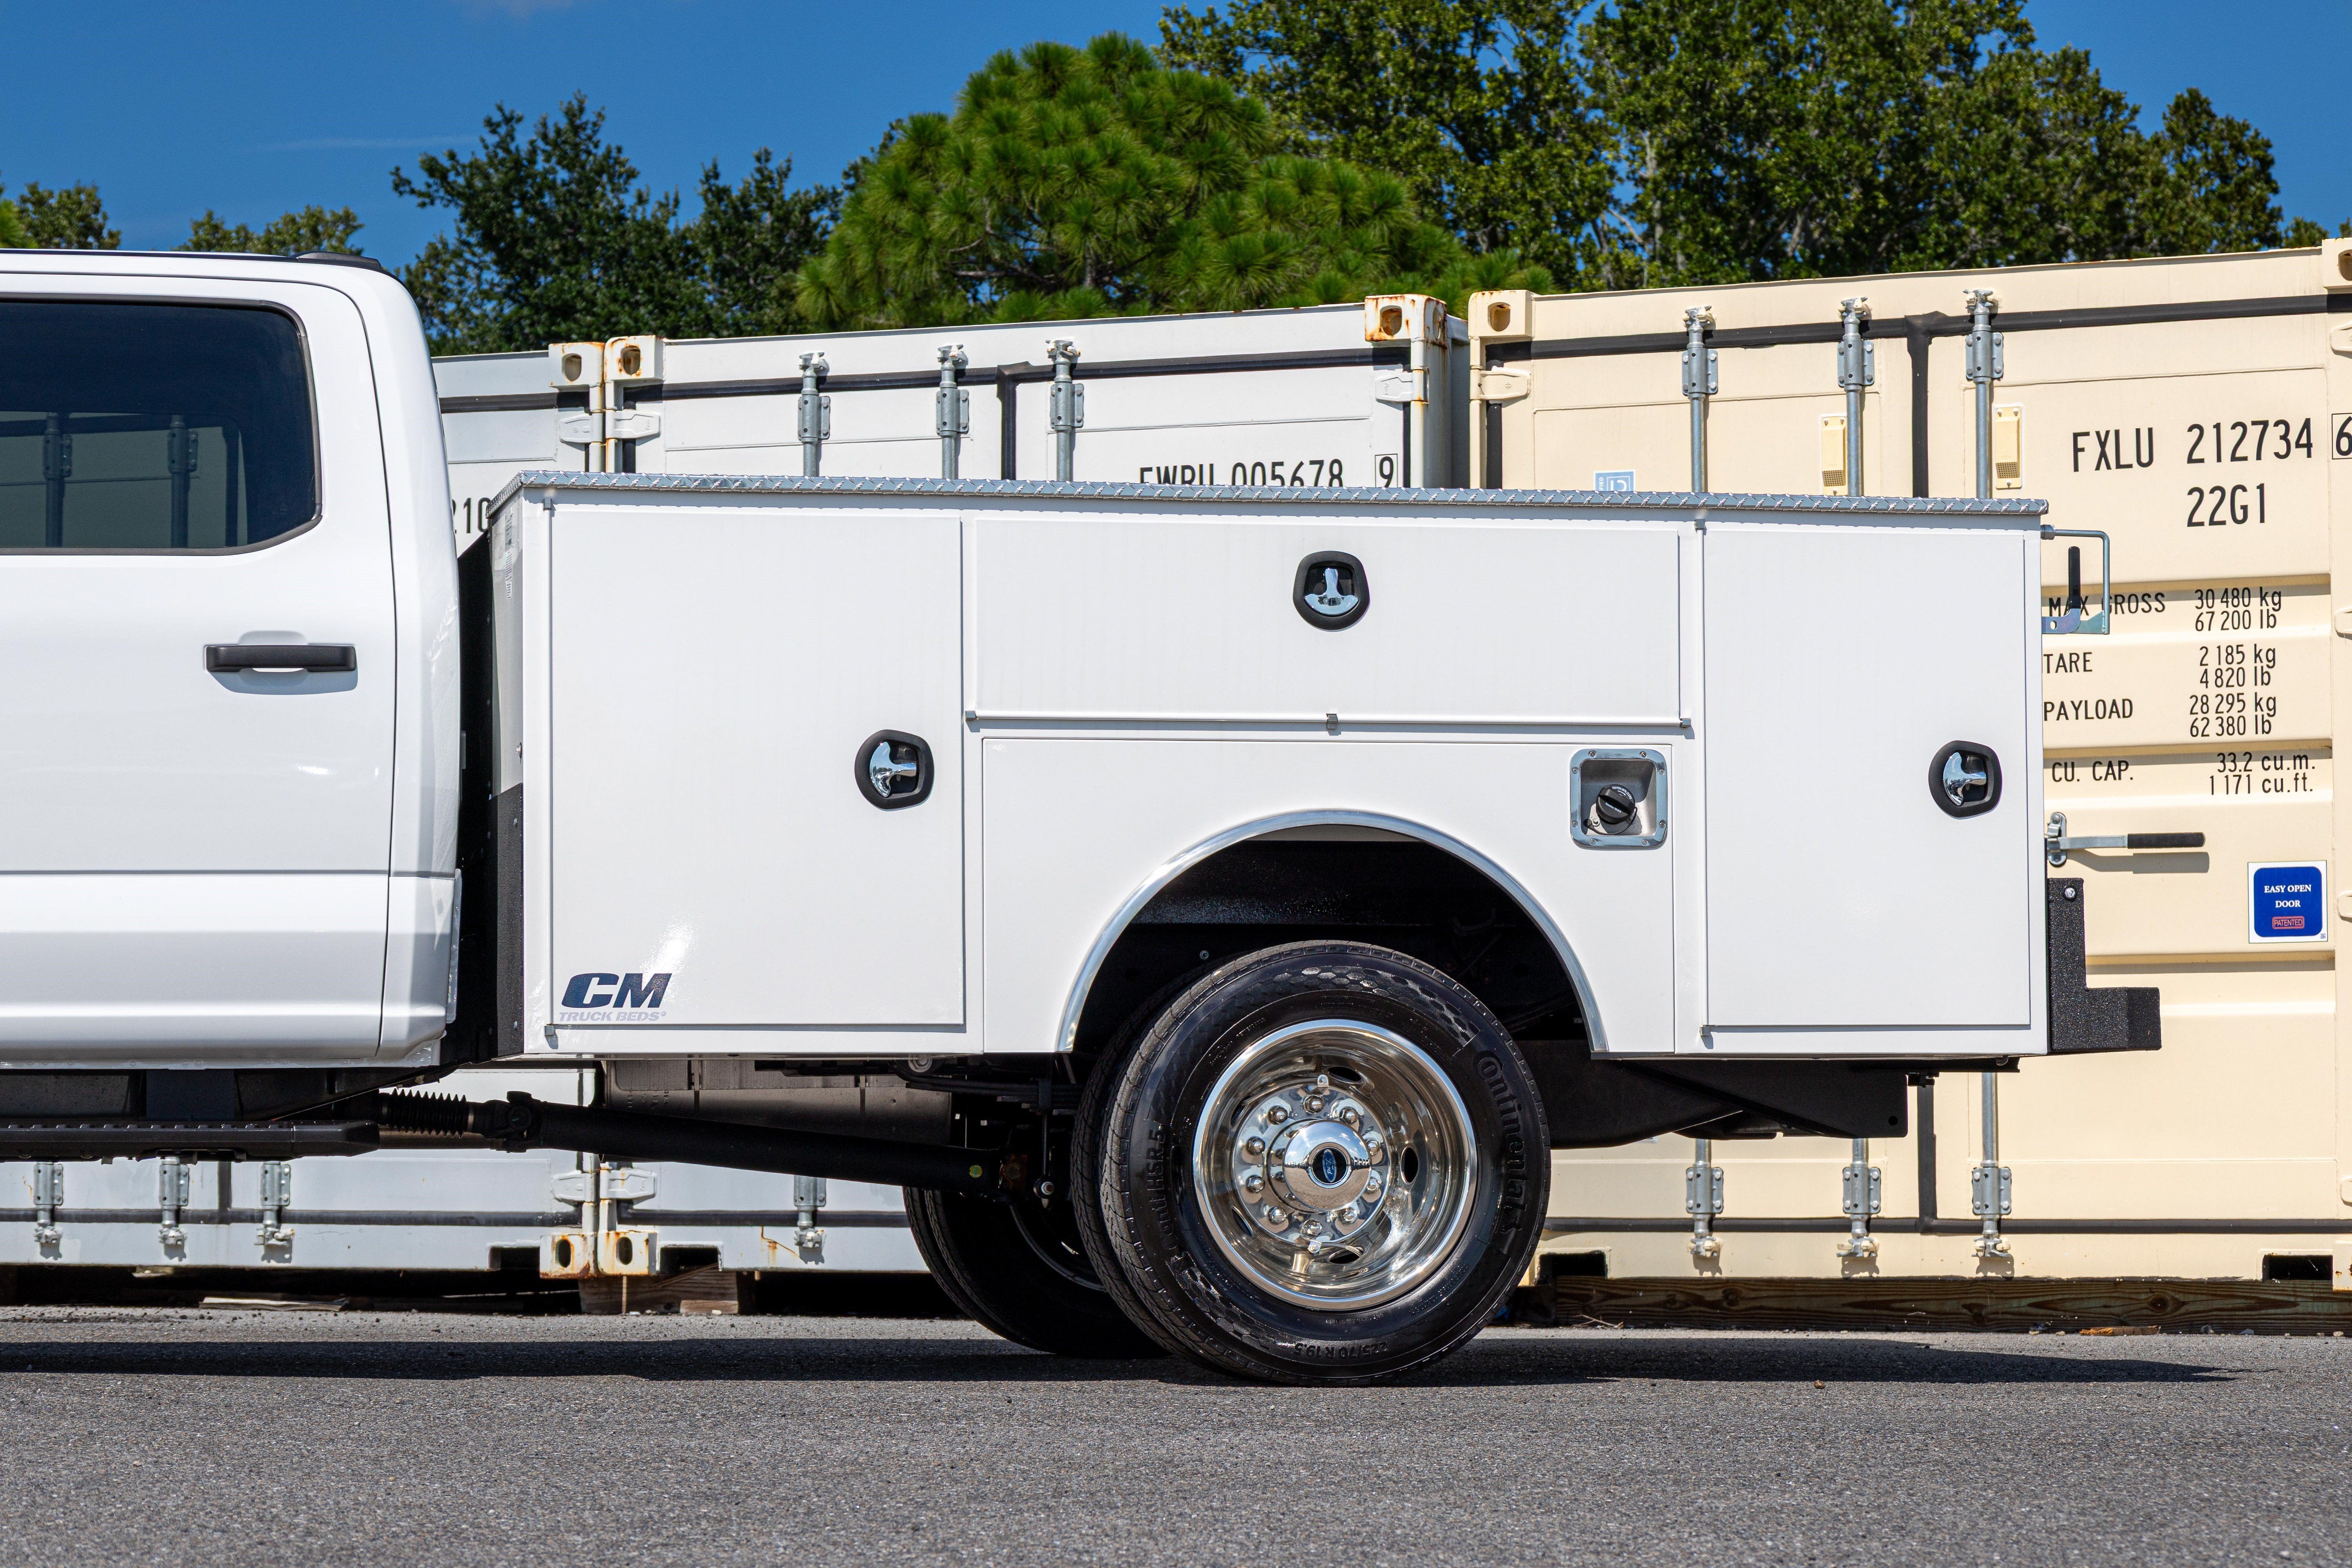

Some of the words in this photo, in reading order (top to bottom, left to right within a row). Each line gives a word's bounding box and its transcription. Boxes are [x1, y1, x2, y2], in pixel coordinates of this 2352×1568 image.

[2072, 427, 2154, 472] FXLU
[2187, 417, 2313, 464] 212734
[2336, 416, 2352, 456] 6
[1378, 457, 1393, 487] 9
[452, 497, 491, 534] 10
[2187, 483, 2265, 528] 22G1
[2259, 587, 2283, 611] kg
[2260, 609, 2277, 629] lb
[2043, 652, 2093, 674] TARE
[2254, 644, 2276, 668] kg
[2254, 666, 2272, 687] lb
[2044, 698, 2133, 722] PAYLOAD
[2254, 693, 2277, 717] kg
[2255, 714, 2272, 735] lb
[2052, 762, 2080, 783] CU.
[2092, 760, 2133, 781] CAP.
[2216, 751, 2252, 773] 33.2
[2261, 754, 2315, 771] cu.m.
[2262, 772, 2313, 793] cu.ft.
[2264, 885, 2286, 893] EASY
[2275, 900, 2301, 908] DOOR
[2274, 919, 2303, 927] PATENTED
[561, 973, 673, 1008] CM
[559, 1011, 613, 1022] TRUCK
[1473, 1050, 1528, 1213] Continental
